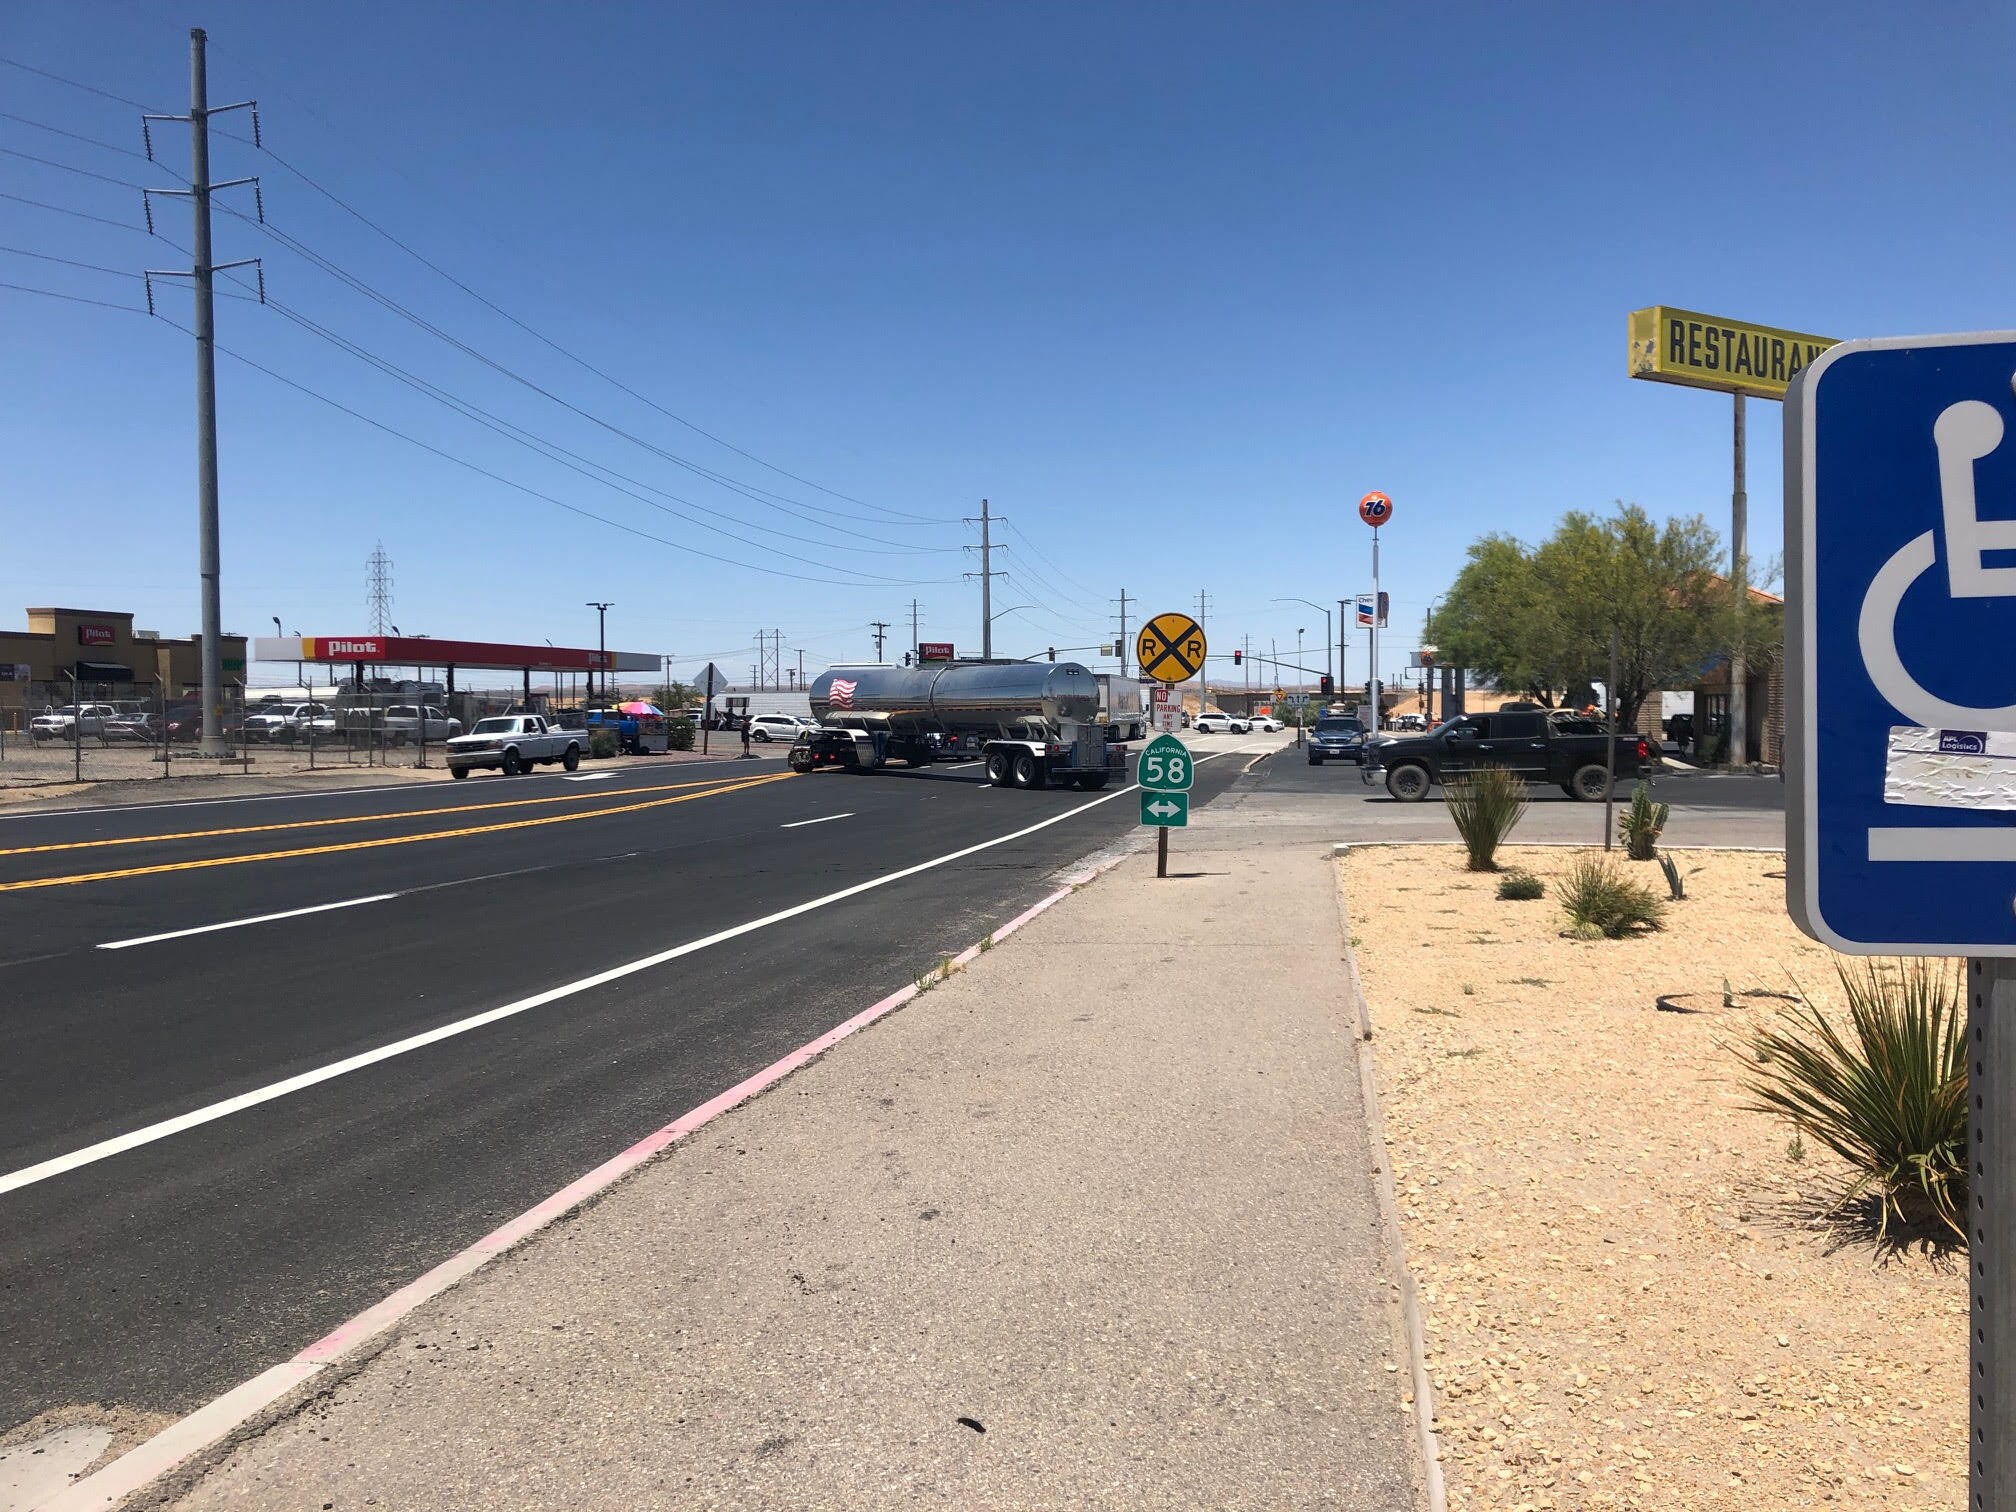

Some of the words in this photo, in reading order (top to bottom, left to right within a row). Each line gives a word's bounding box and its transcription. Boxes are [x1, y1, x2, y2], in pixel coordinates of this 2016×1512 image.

[1669, 319, 1828, 383] RESTAURA
[1365, 500, 1386, 516] 76
[86, 629, 111, 639] Pilot
[328, 641, 377, 656] Pilot
[925, 646, 950, 655] Pilot
[1142, 639, 1157, 656] R
[1187, 641, 1201, 658] R
[1156, 691, 1167, 701] NO
[1156, 704, 1181, 713] PARKING
[1145, 746, 1187, 758] CALIFORNIA
[1941, 742, 1978, 751] Logistics
[1146, 757, 1185, 784] 58
